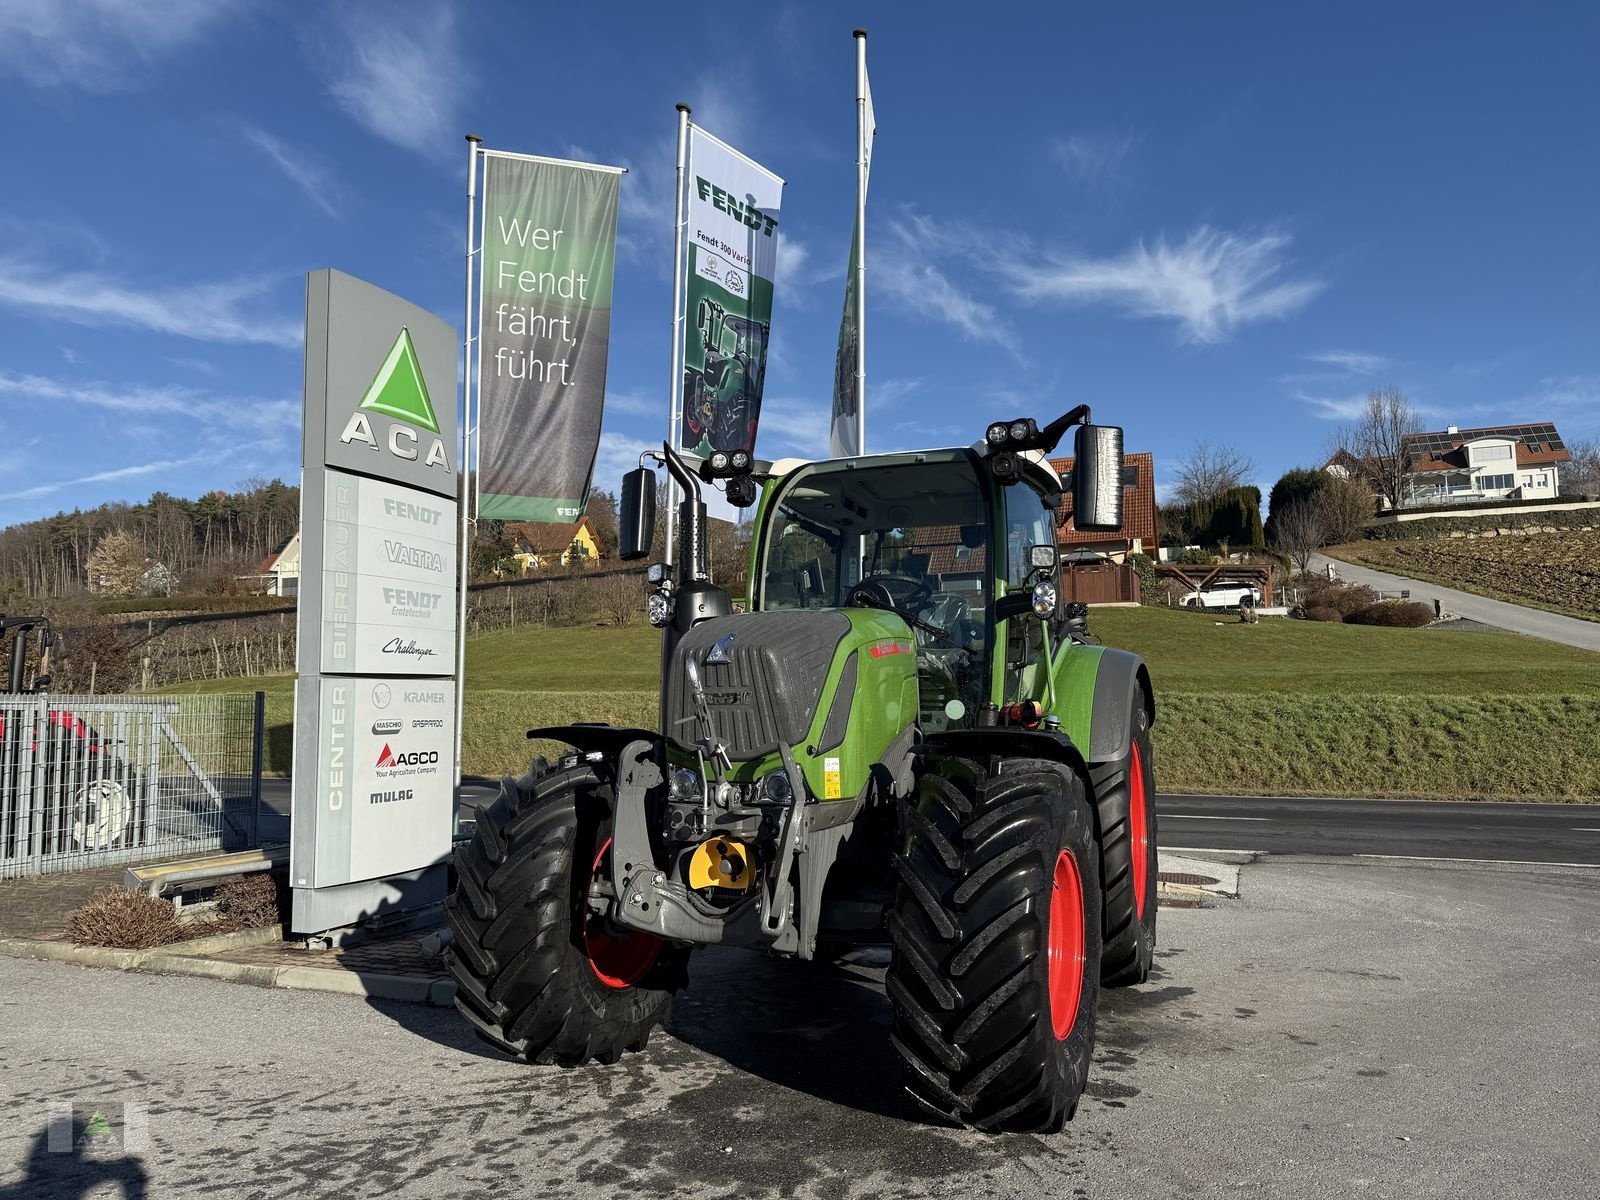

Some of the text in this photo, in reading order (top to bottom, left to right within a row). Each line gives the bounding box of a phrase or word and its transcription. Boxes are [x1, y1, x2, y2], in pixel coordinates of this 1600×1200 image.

[696, 175, 778, 238] FENDT
[498, 215, 563, 250] Wer
[697, 229, 751, 266] Fendt 300 Vario
[498, 260, 588, 300] Fendt
[495, 303, 577, 347] fährt,
[494, 347, 575, 386] führt.
[339, 411, 452, 475] ACA
[383, 498, 442, 526] FENDT
[556, 507, 581, 516] FEN
[384, 540, 443, 573] VALTRA
[382, 587, 442, 609] FENDT
[391, 606, 431, 619] Erntetechnik
[382, 637, 439, 660] Challenger
[404, 691, 445, 704] KRAMER
[376, 721, 402, 729] MASCHIO
[329, 685, 346, 812] CENTER
[396, 751, 439, 766] AGCO
[375, 766, 437, 779] Your Agriculture Company
